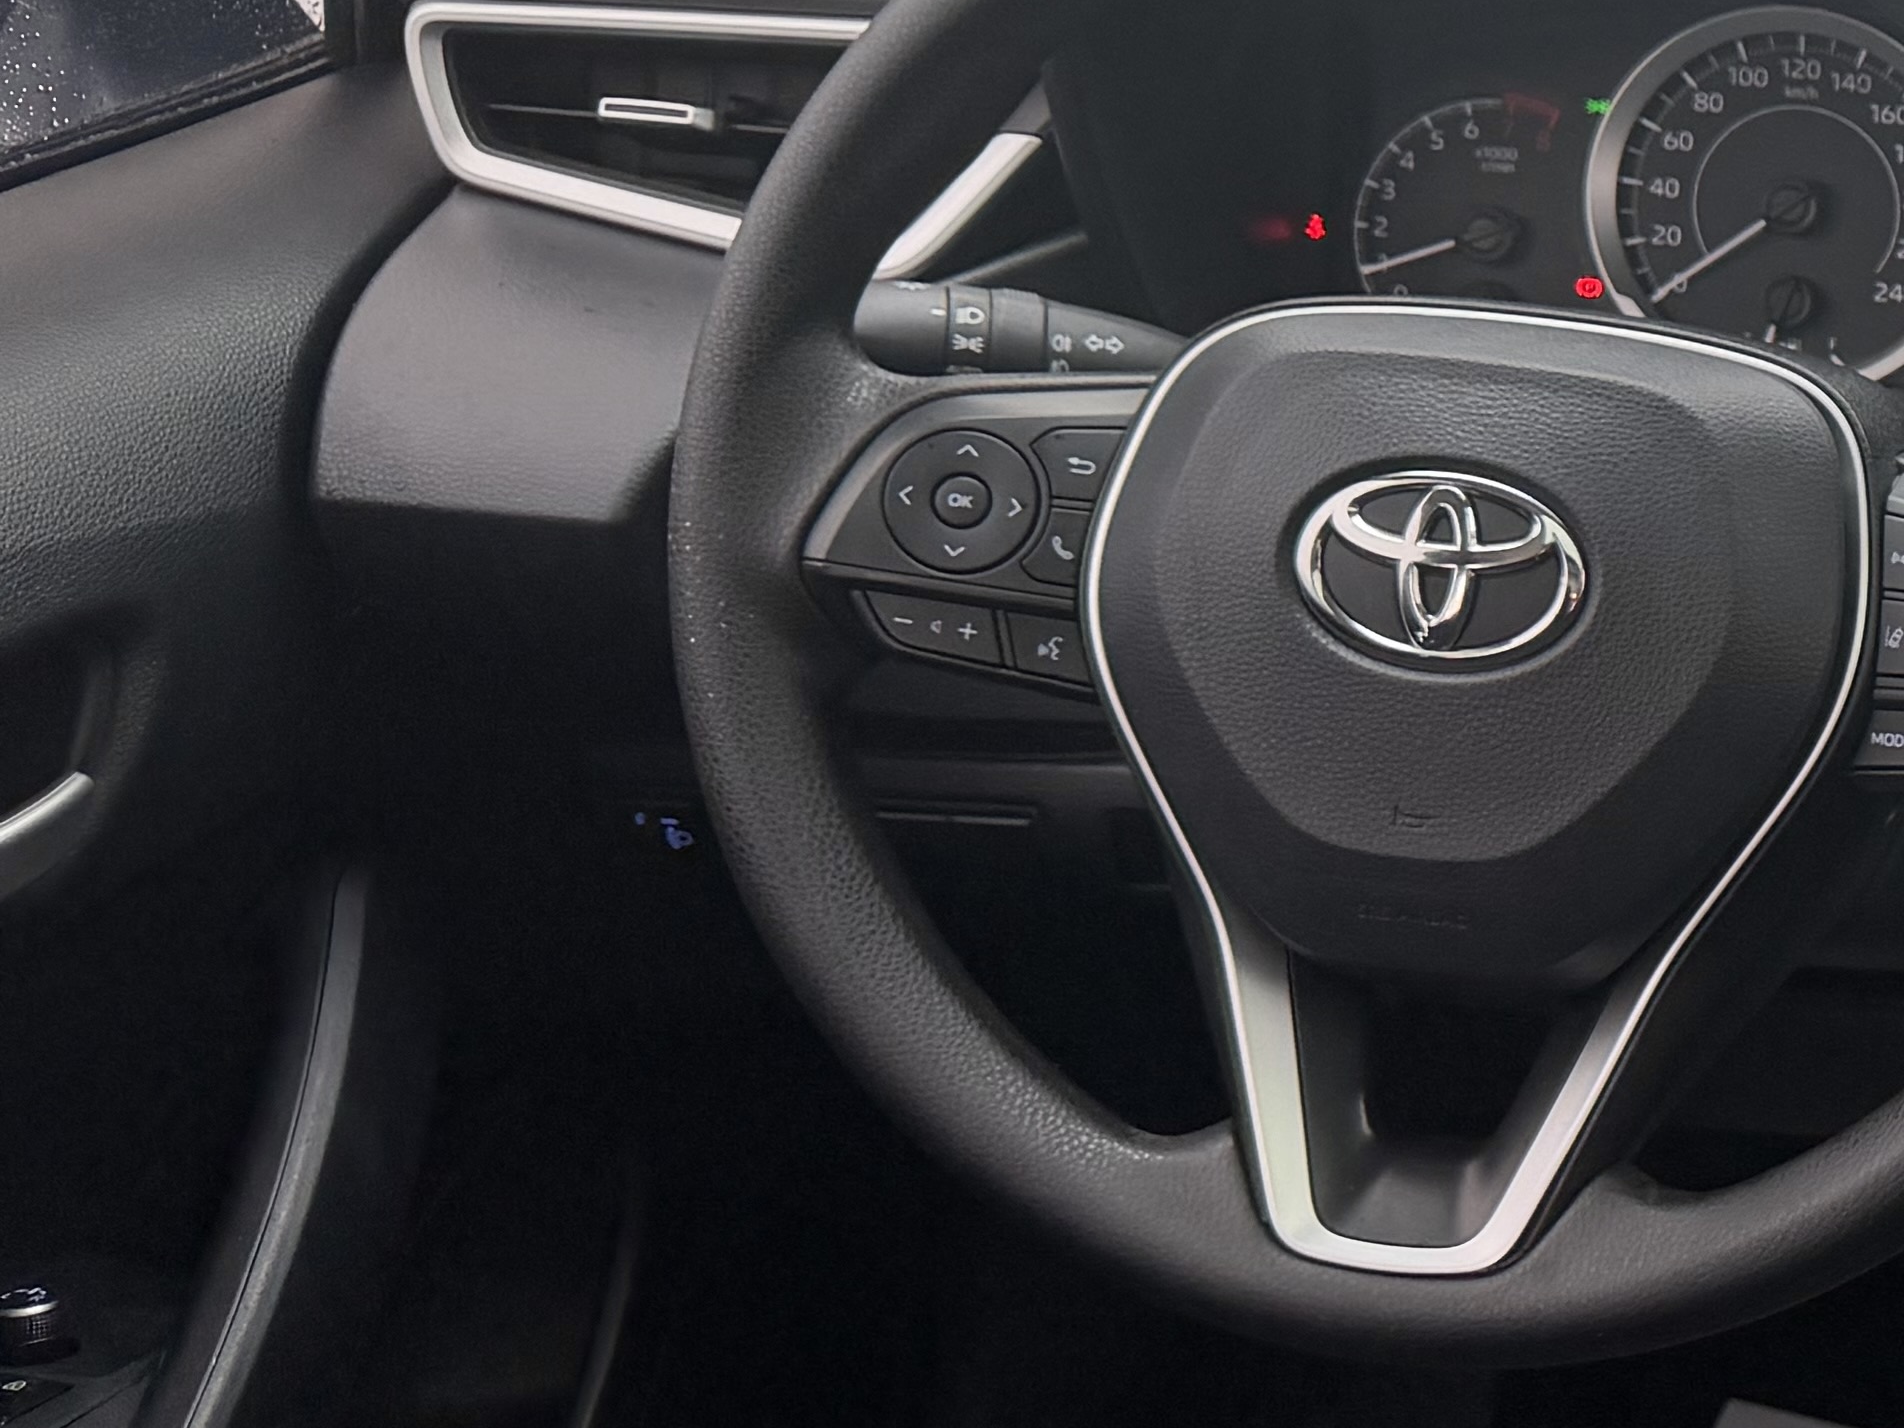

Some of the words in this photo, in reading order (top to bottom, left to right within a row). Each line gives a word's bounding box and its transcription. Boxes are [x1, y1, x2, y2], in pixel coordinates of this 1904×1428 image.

[1728, 66, 1769, 89] 100
[1780, 58, 1822, 80] 120
[1831, 72, 1872, 94] 140
[1693, 92, 1724, 114] 80
[1430, 131, 1444, 151] 5
[1464, 121, 1480, 140] 6
[1663, 130, 1694, 152] 60
[1400, 151, 1415, 170] 4
[1381, 179, 1396, 200] 3
[1649, 178, 1680, 199] 40
[1374, 216, 1388, 238] 2
[1651, 225, 1682, 247] 20
[947, 492, 973, 508] OK
